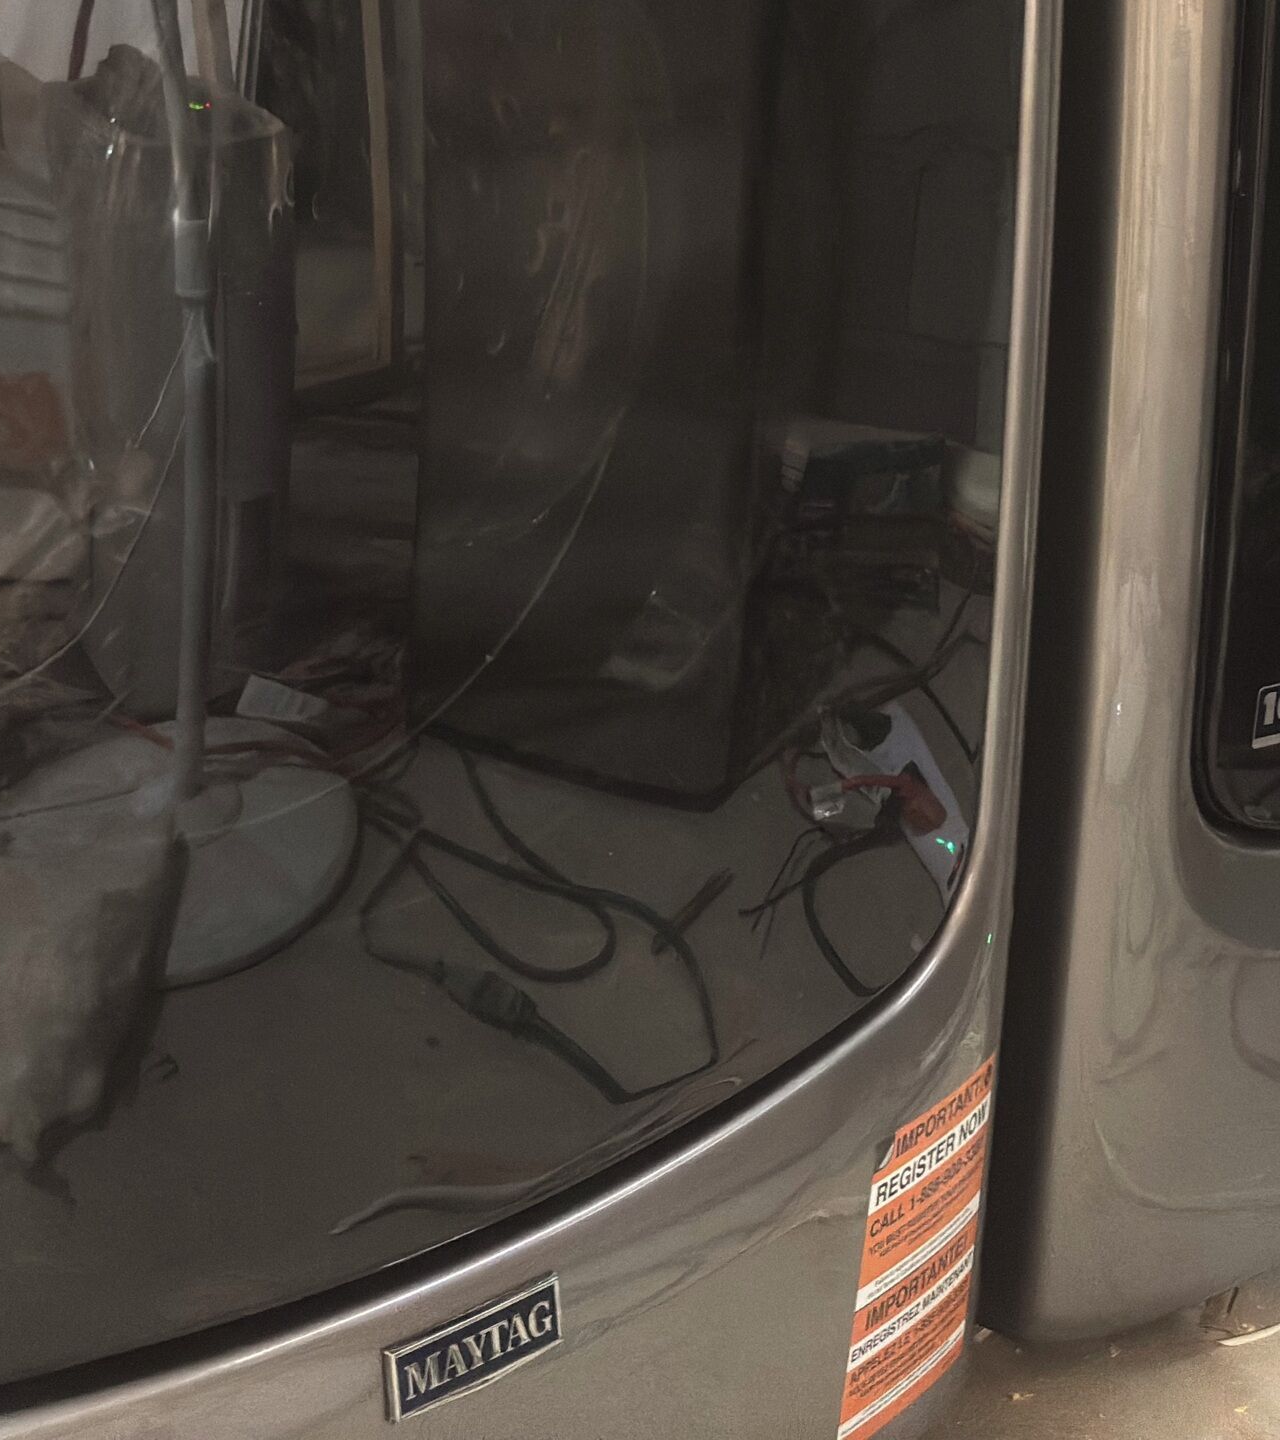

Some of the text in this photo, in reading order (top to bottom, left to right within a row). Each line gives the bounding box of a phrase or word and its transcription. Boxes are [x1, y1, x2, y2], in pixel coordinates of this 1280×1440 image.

[875, 1131, 956, 1207] REGISTER
[958, 1100, 989, 1145] NOW
[870, 1205, 905, 1238] CALL
[404, 1300, 553, 1401] MAYTAG
